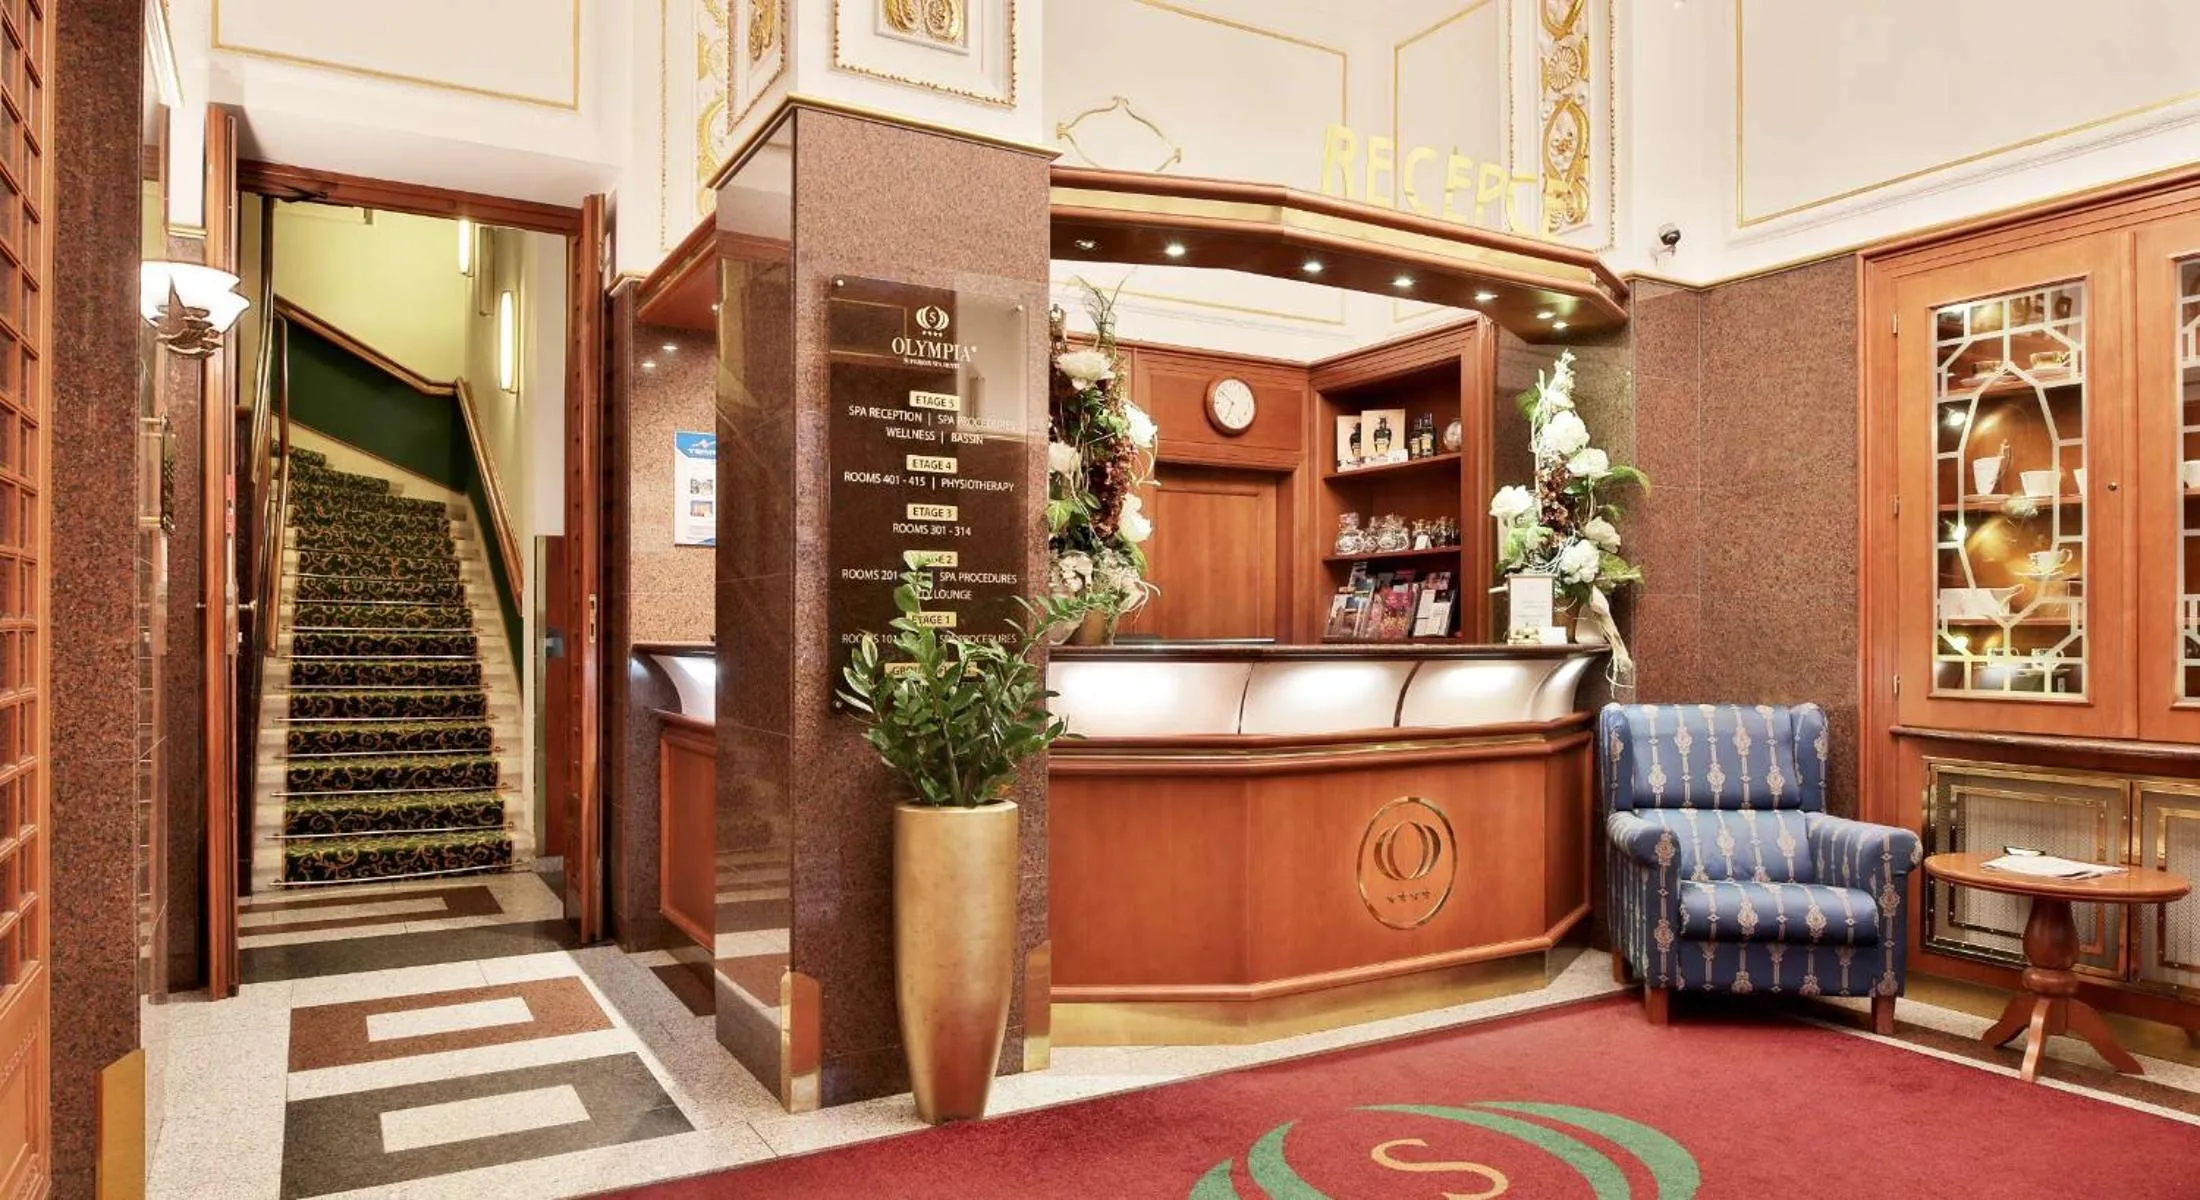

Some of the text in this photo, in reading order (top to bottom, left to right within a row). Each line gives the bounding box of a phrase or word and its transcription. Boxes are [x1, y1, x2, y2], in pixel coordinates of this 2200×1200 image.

[891, 336, 971, 362] OLYMPIA
[915, 395, 954, 408] ETAGE 5
[848, 405, 867, 417] SPA
[869, 407, 922, 422] RECEPTION
[938, 414, 955, 425] SPA
[885, 427, 983, 445] WELLNESS BASSIN
[912, 459, 952, 470] ETAGE 4
[844, 471, 881, 483] ROOMS
[883, 474, 900, 485] 401
[908, 476, 926, 487] 415
[941, 478, 1014, 492] PHYSIOTHERAPY
[913, 507, 944, 517] ETAGE
[892, 523, 929, 535] ROOMS
[930, 525, 946, 535] 301
[954, 526, 972, 536] 314
[946, 555, 953, 564] 2
[841, 568, 1017, 584] ROOMS 201 SPA PROCEDURES
[933, 589, 973, 600] LOUNGE
[912, 615, 943, 625] ETAGE
[841, 633, 880, 644] ROOS
